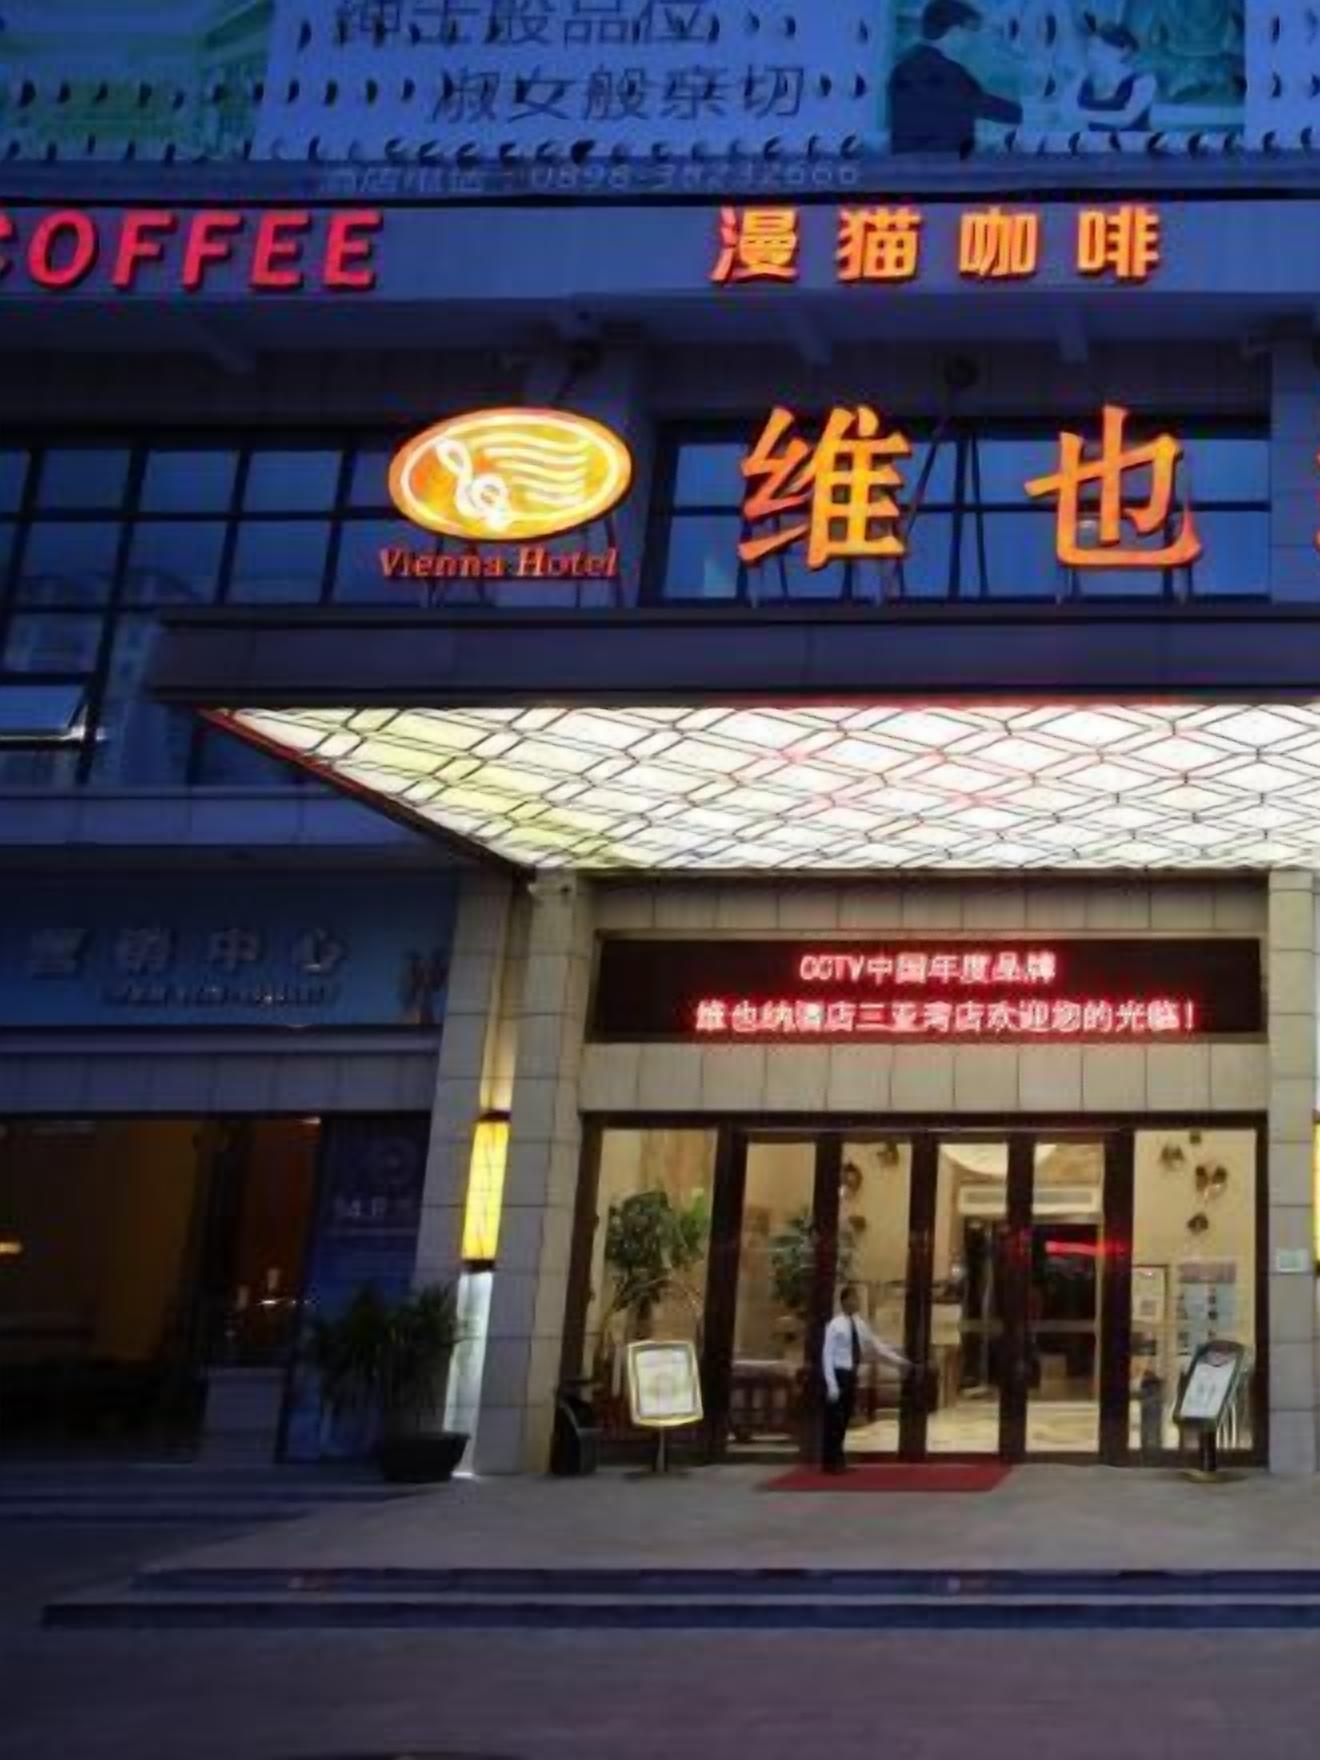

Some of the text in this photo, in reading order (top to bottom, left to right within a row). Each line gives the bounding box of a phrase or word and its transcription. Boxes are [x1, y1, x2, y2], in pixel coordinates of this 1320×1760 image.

[0, 209, 381, 287] OFFEE
[712, 205, 1159, 282] 漫猫咖啡
[379, 545, 618, 580] Vienna Hotel
